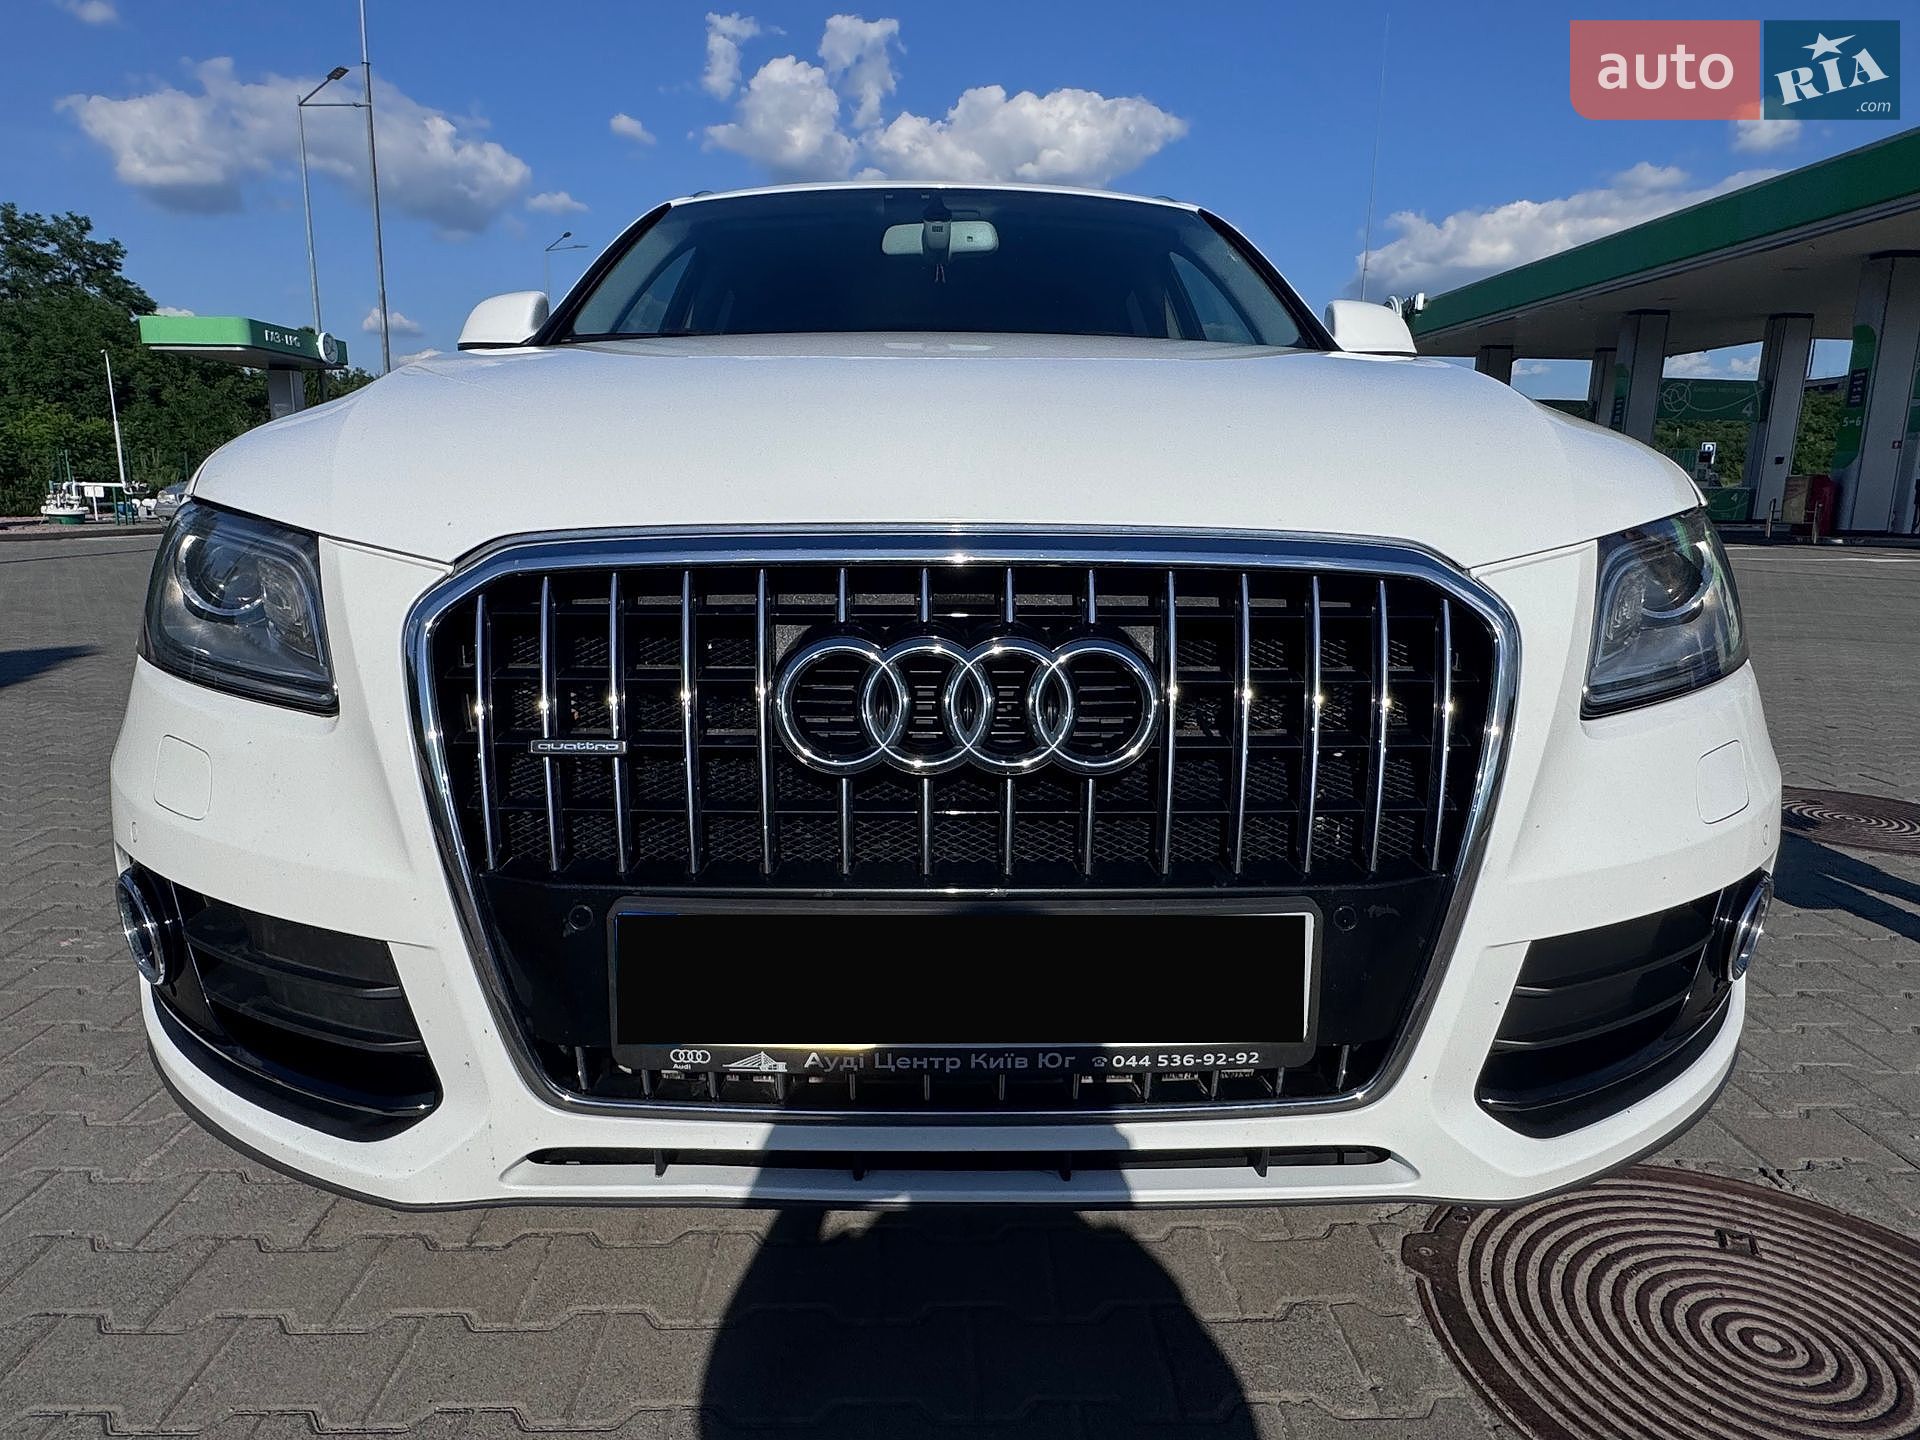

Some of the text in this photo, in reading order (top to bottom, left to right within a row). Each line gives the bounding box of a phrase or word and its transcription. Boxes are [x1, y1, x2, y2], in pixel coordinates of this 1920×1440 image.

[1741, 400, 1754, 417] 4
[537, 742, 619, 751] quattro
[803, 1052, 1260, 1073] Ауді Центр Київ Юг 044 536-92-92
